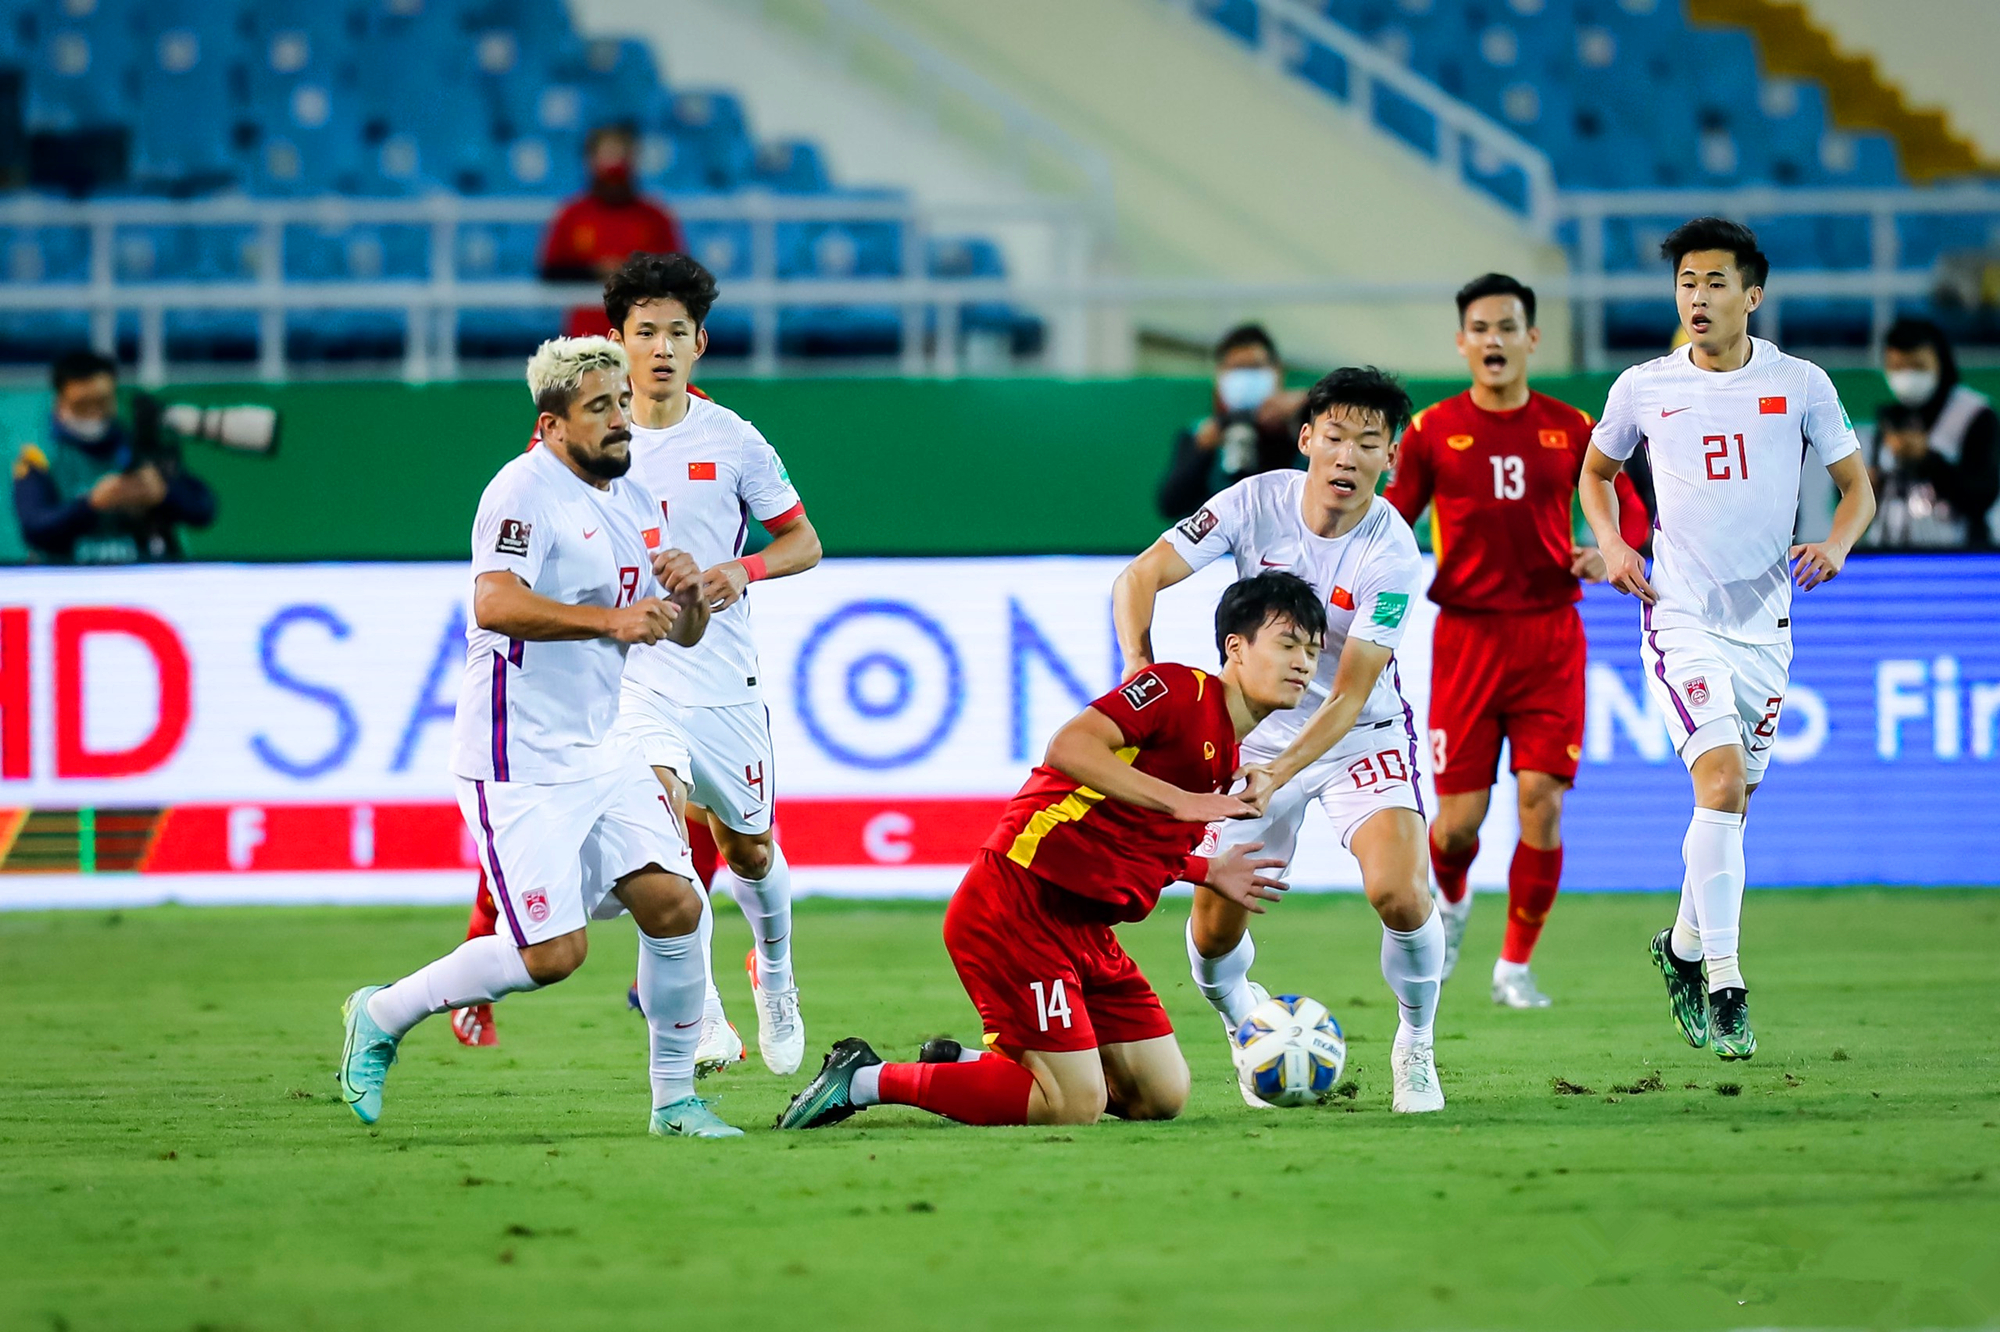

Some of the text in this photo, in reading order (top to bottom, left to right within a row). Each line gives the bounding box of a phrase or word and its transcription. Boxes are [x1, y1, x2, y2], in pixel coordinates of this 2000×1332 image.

[1489, 455, 1525, 500] 13
[1702, 433, 1748, 481] 21
[745, 760, 763, 801] 4
[1348, 750, 1407, 789] 20
[1030, 979, 1071, 1031] 14
